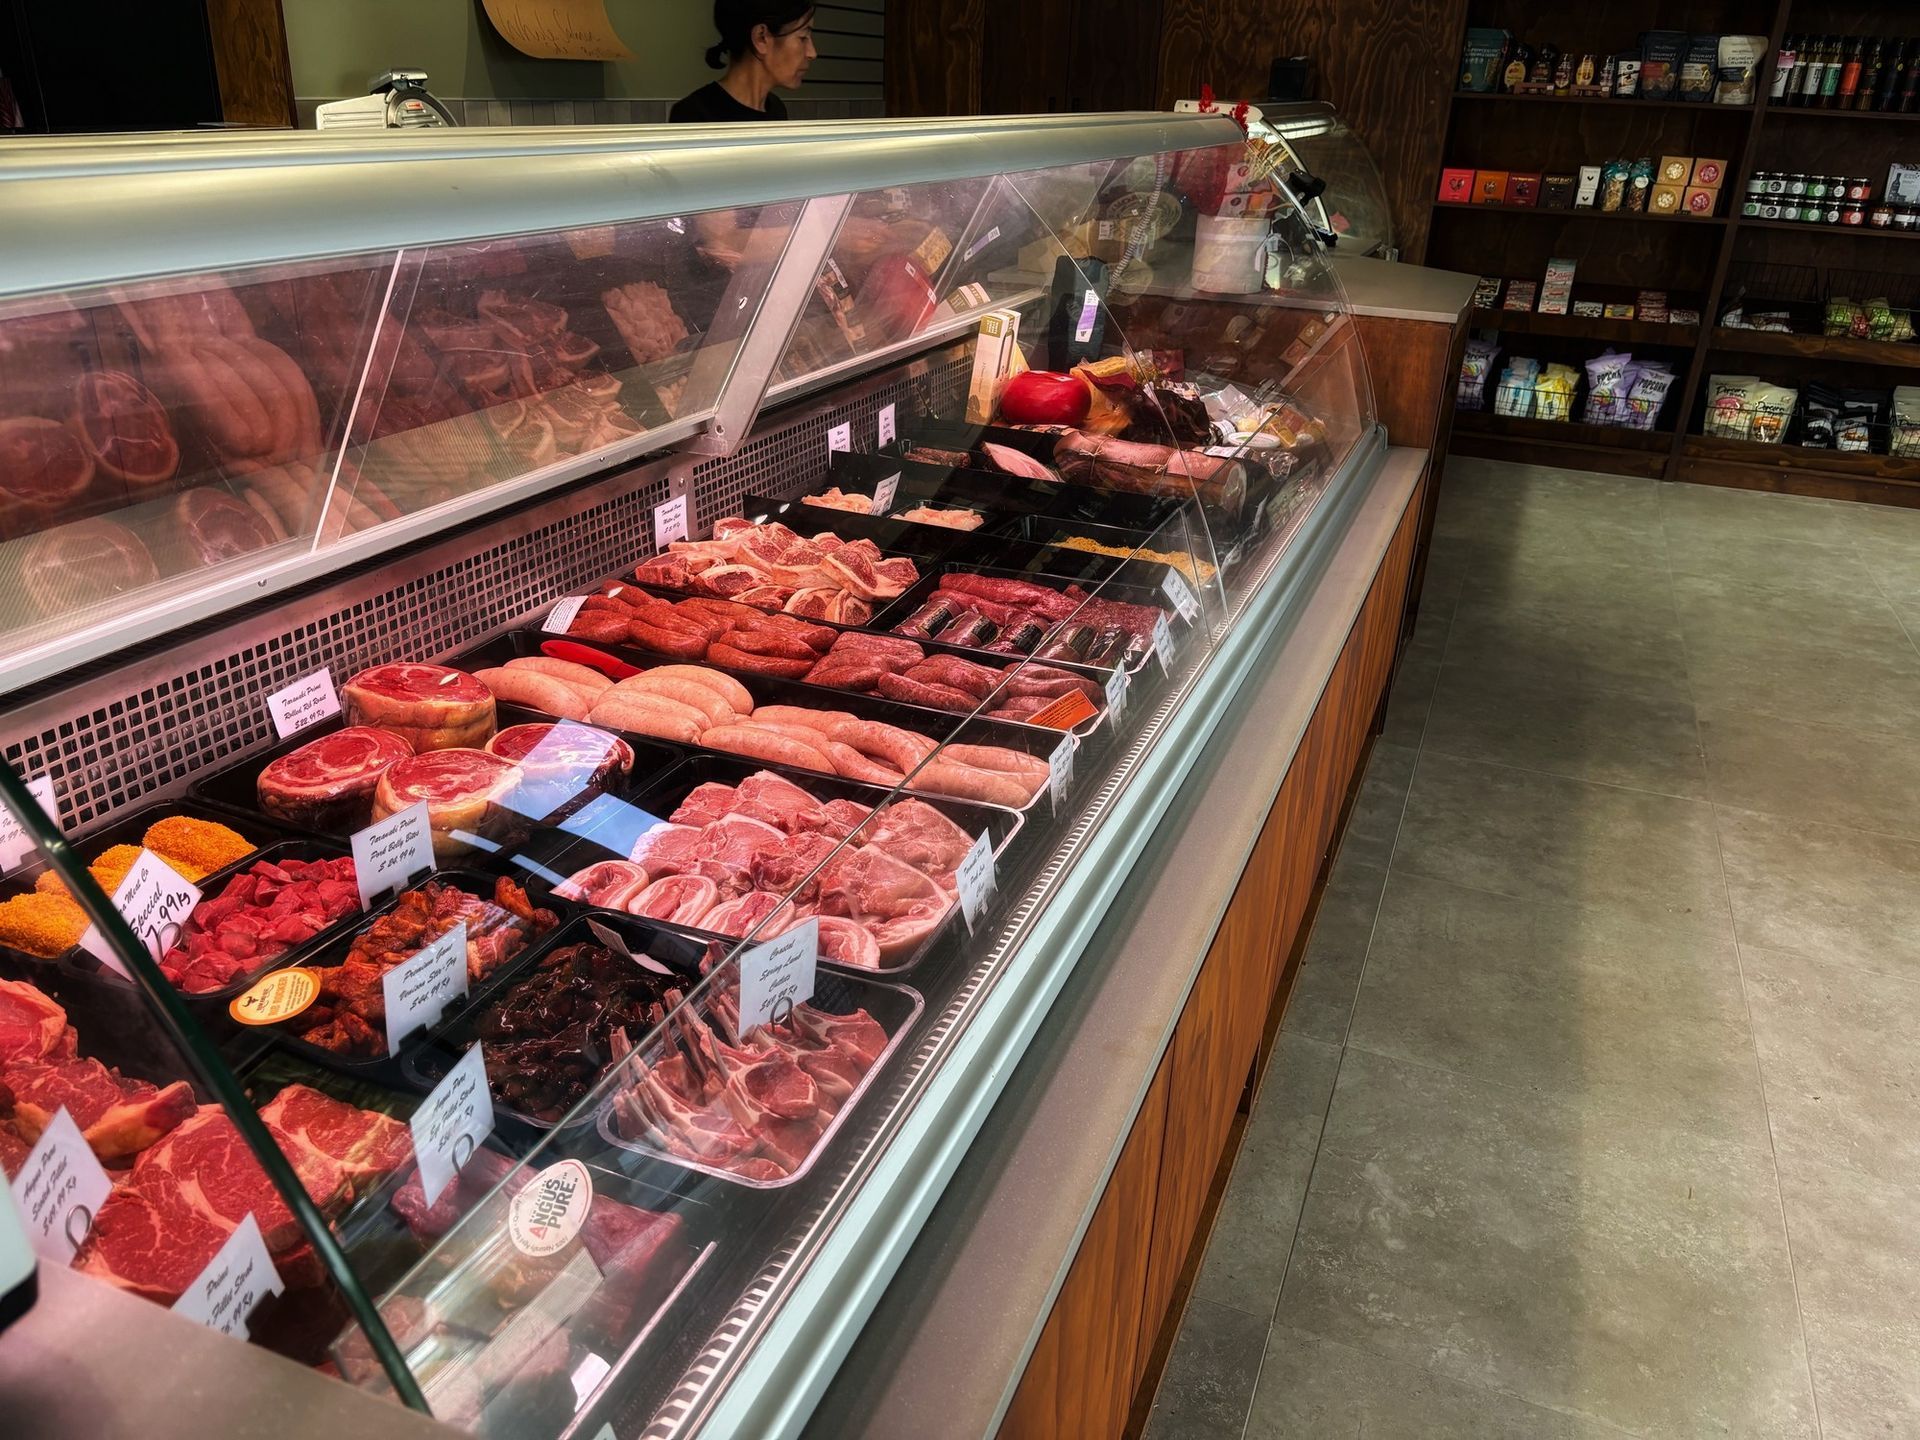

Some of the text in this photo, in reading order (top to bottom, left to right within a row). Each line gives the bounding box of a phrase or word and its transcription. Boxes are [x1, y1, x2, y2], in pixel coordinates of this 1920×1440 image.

[1638, 378, 1668, 394] POPCORN
[369, 816, 418, 846] Taranaki Prime
[388, 837, 404, 853] Belly
[129, 881, 163, 938] Special
[529, 1178, 561, 1241] ANGUS
